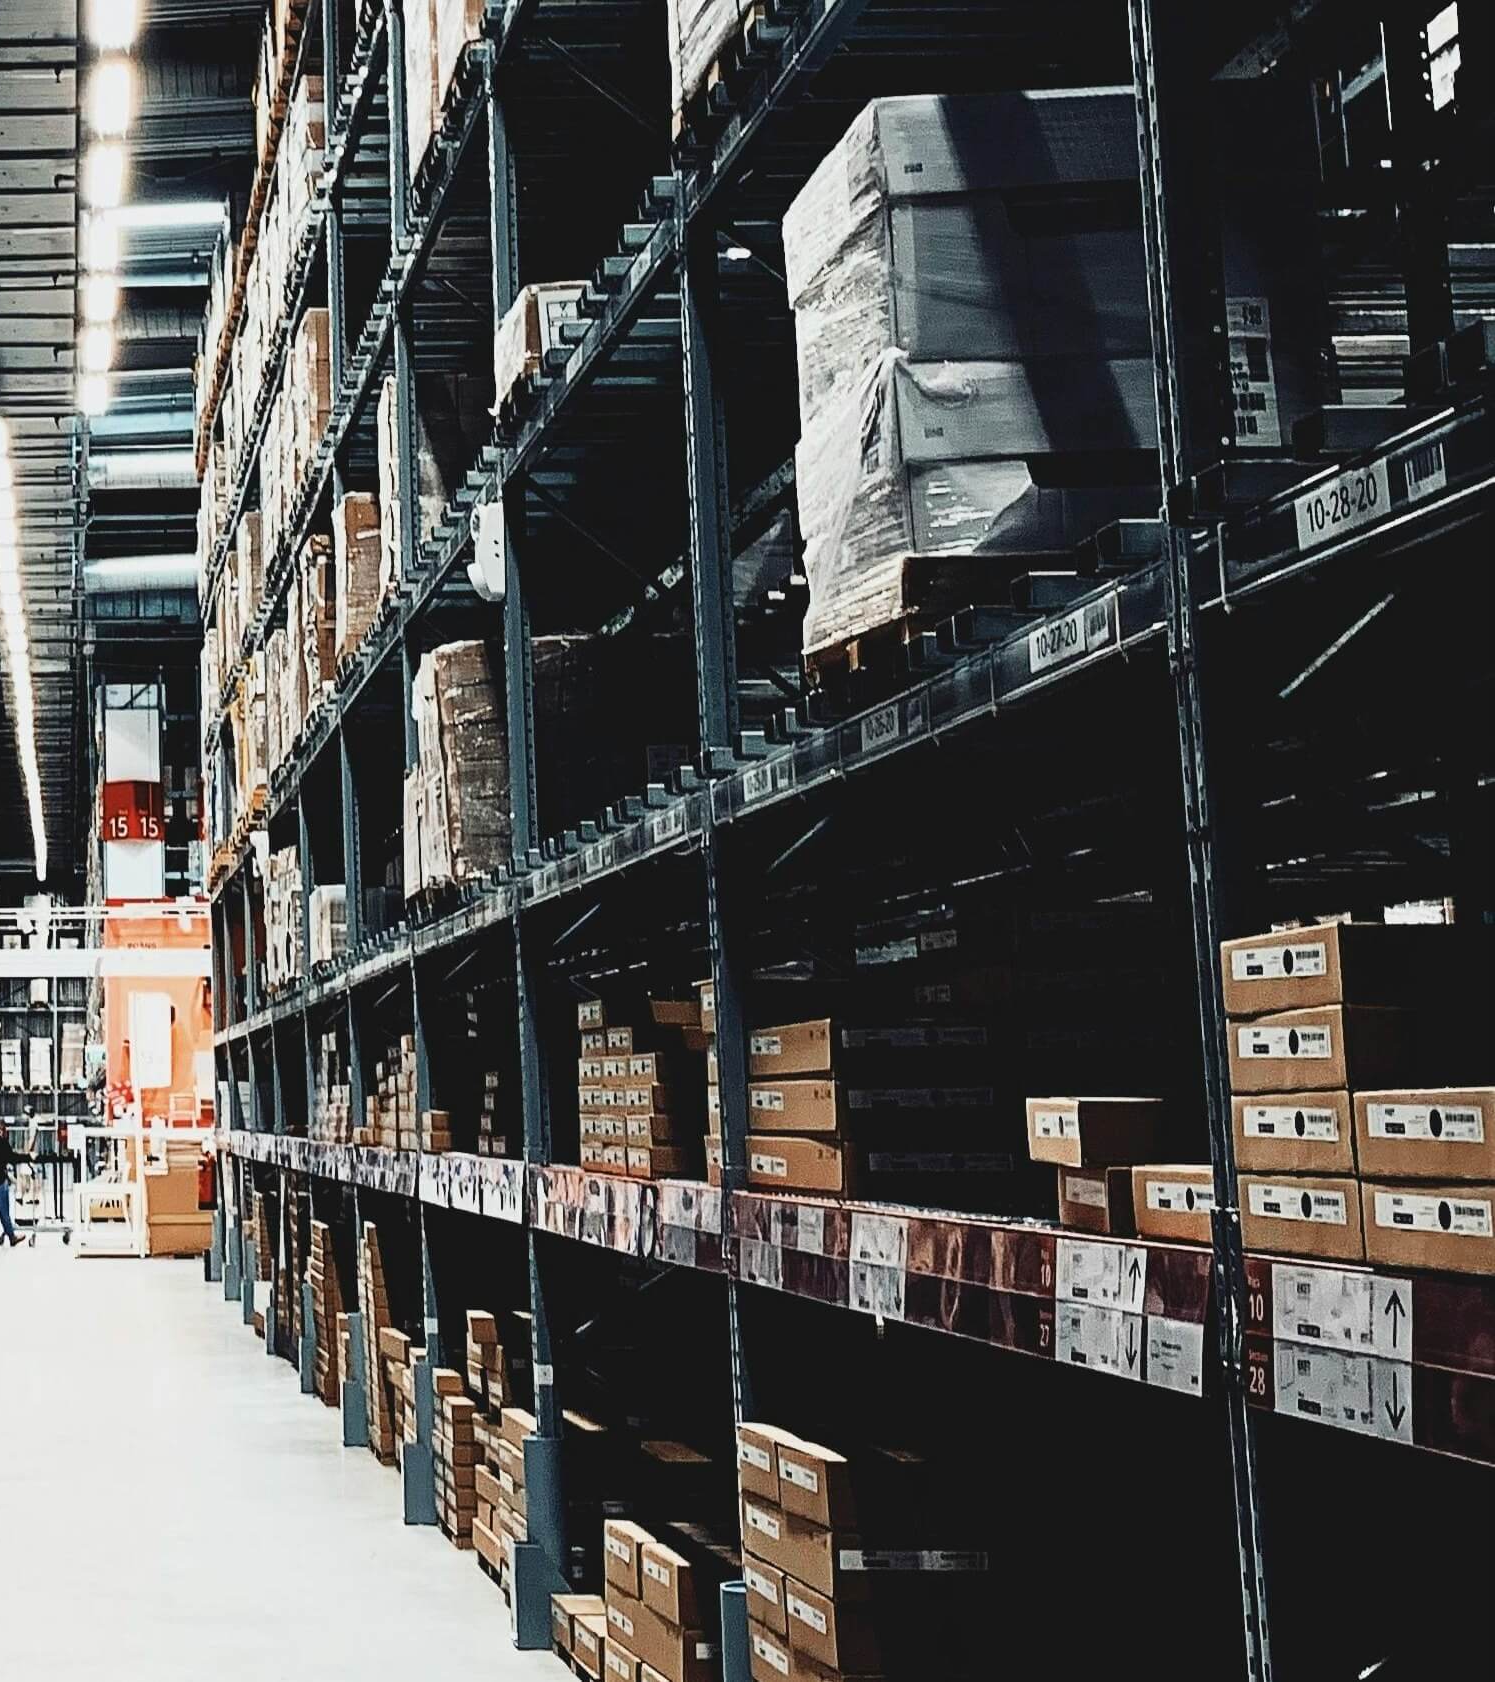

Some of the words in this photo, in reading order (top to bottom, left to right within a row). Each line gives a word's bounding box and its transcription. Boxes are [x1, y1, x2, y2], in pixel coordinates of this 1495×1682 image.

[1306, 473, 1378, 534] 10-28-20
[1036, 618, 1078, 660] 10-27-20
[109, 815, 128, 838] 15
[140, 815, 159, 838] 15
[1249, 1293, 1264, 1321] 10
[1249, 1366, 1266, 1395] 28
